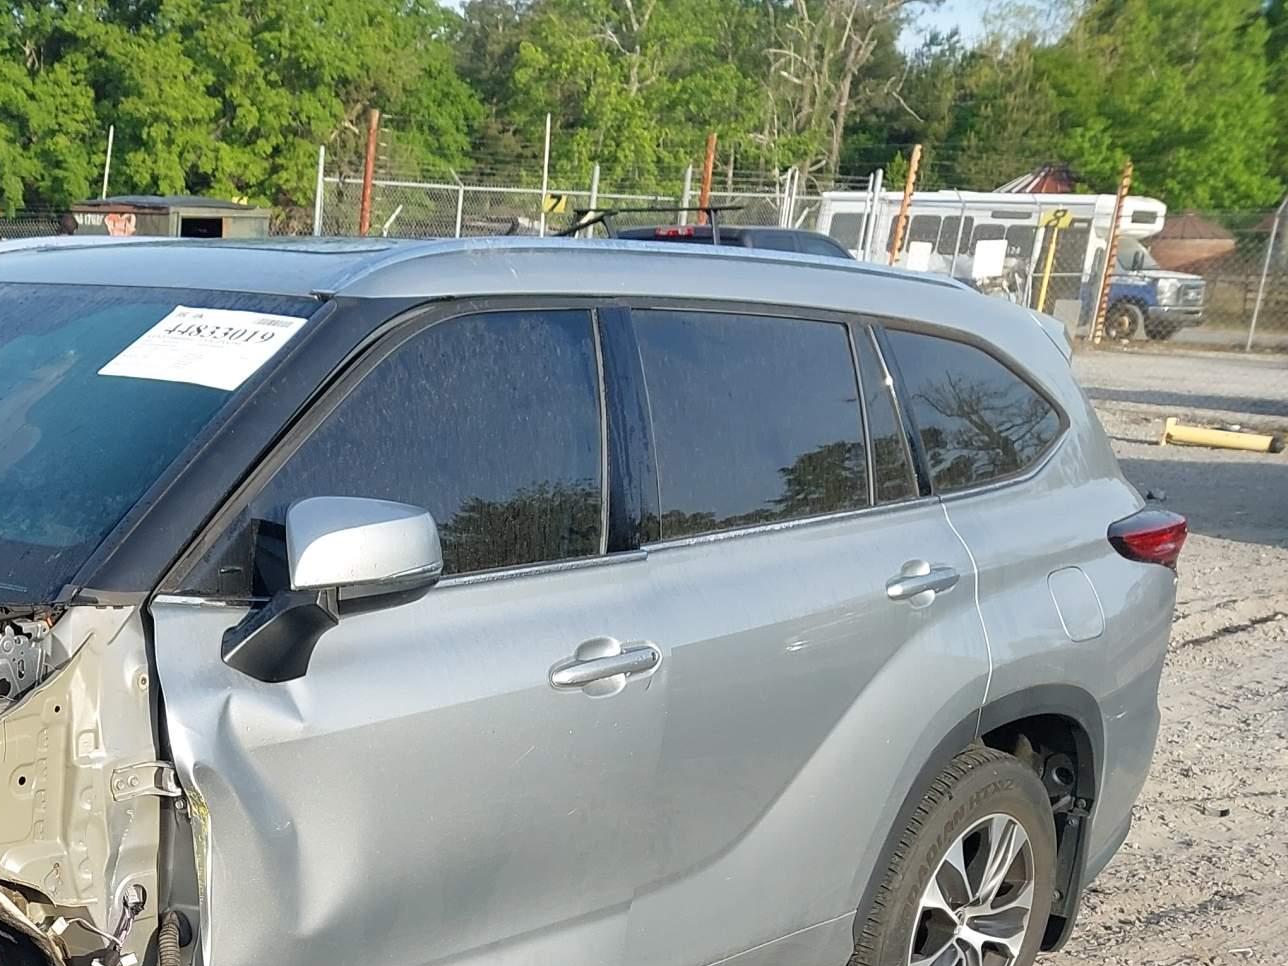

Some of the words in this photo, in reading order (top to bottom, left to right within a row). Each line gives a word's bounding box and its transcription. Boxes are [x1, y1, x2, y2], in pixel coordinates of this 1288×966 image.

[548, 193, 562, 212] 7
[1044, 208, 1068, 228] 8
[164, 322, 276, 344] 44833019
